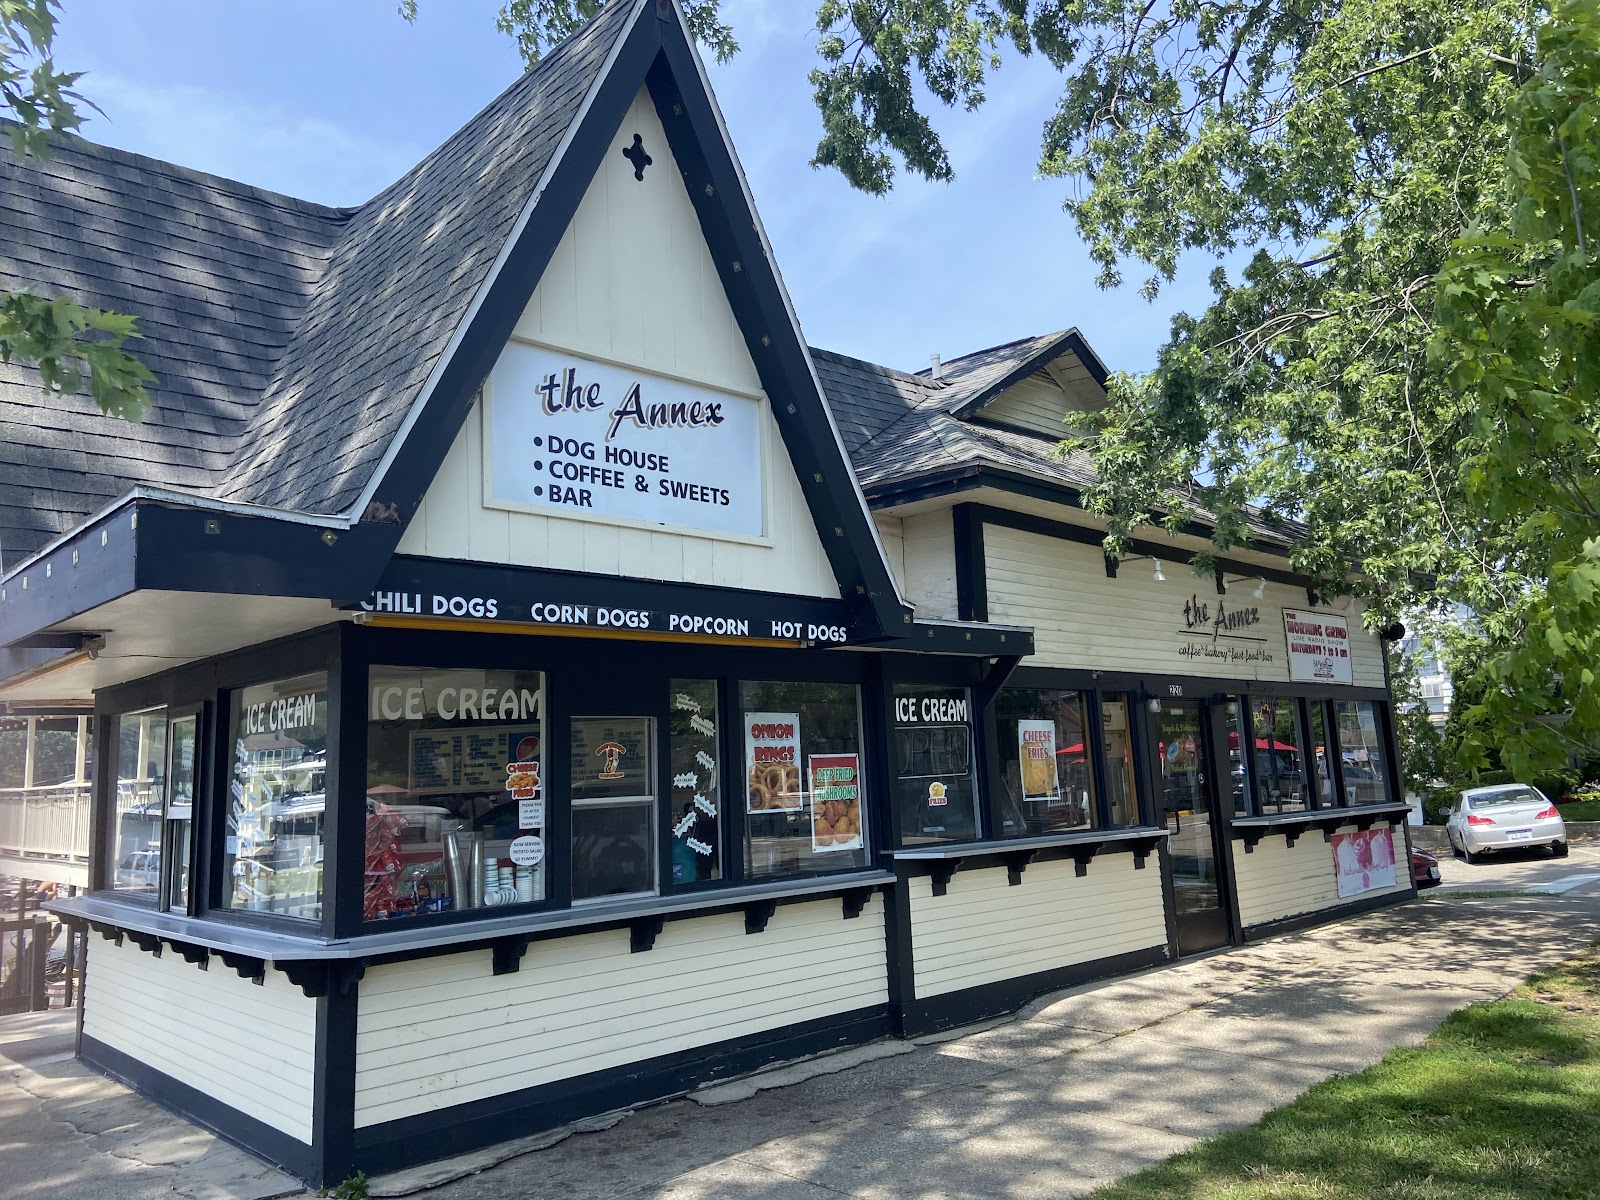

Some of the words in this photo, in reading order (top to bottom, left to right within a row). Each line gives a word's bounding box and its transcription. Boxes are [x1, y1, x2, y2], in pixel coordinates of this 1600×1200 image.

[536, 367, 604, 416] the
[605, 381, 725, 443] Annex
[548, 435, 595, 461] DOG
[604, 445, 669, 473] HOUSE
[549, 460, 625, 489] COFFEE
[634, 474, 650, 494] &
[659, 479, 730, 507] SWEETS
[549, 484, 593, 508] BAR
[432, 595, 498, 618] DOGS
[530, 602, 588, 625] CORN
[596, 608, 650, 629] DOGS
[1183, 593, 1211, 628] the
[1214, 599, 1260, 642] Annex
[669, 614, 749, 637] POPCORN
[771, 621, 803, 639] HOT
[808, 624, 847, 642] DOGS
[1286, 620, 1322, 636] MORNING
[1325, 626, 1346, 639] GRIND
[1291, 642, 1322, 655] SATURDAYS
[1169, 685, 1182, 696] 220
[246, 702, 265, 734] ICE
[269, 693, 316, 731] CREAM
[372, 686, 424, 720] ICE
[437, 687, 542, 720] CREAM
[895, 697, 918, 722] ICE
[921, 697, 968, 722] CREAM
[751, 723, 794, 739] ONION
[1023, 730, 1052, 742] CHEESE
[754, 746, 795, 762] RINGS
[1027, 748, 1049, 759] FRIES
[817, 768, 834, 782] DEEP
[835, 767, 853, 781] FRIED
[816, 785, 857, 800] MUSHROOMS
